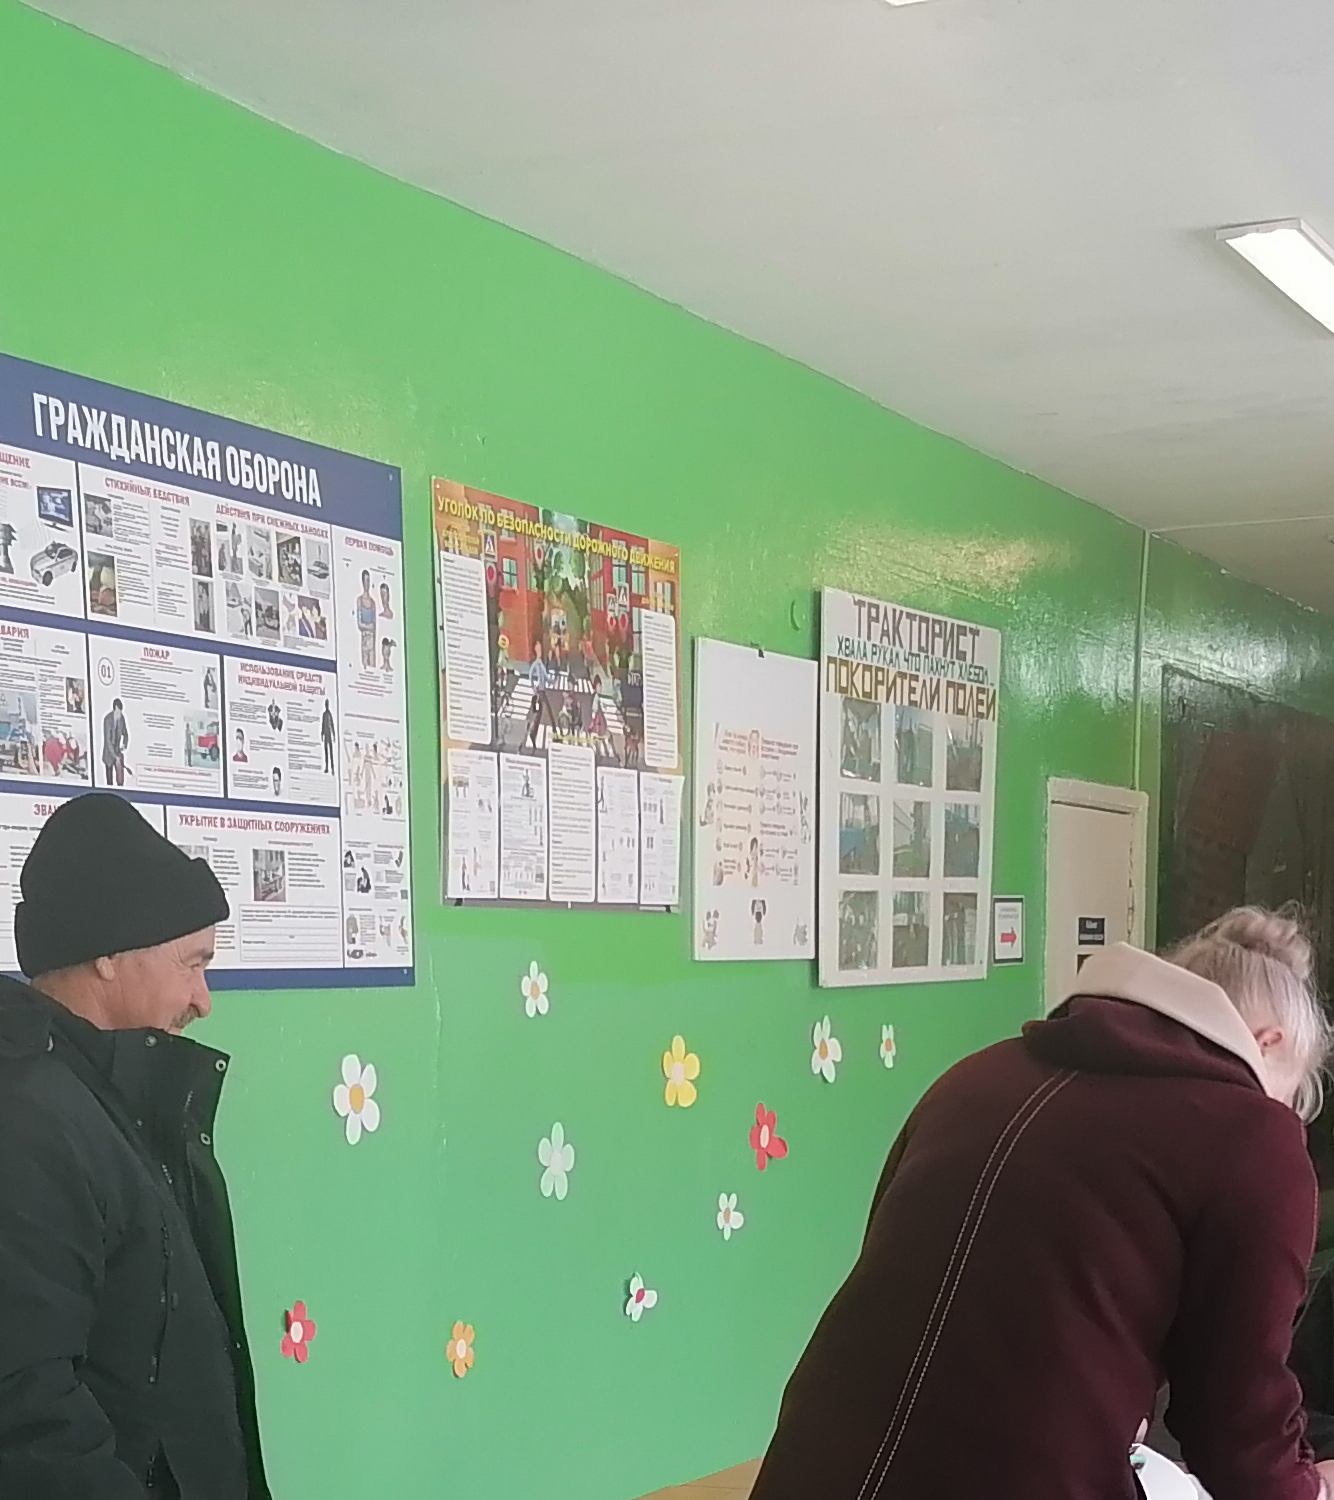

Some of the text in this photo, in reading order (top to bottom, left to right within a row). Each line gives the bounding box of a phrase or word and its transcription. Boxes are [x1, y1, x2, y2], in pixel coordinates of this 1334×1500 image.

[32, 391, 323, 509] ГРАЖДАНСКАЯ ОБОРОНА
[437, 495, 675, 573] УГОЛОК ПО БЕЗОПАСНОСТИ ДОРОЖНОГО ДВИЖЕНИЯ
[143, 647, 170, 660] ПОЖАР
[852, 595, 981, 664] ТРАКТОРИСТ
[101, 665, 111, 678] 01
[837, 635, 867, 661] ХВАЛА
[904, 651, 921, 673] ЧТО
[923, 655, 956, 679] ПАХНУТ
[826, 655, 941, 712] ПОКОРИТЕЛИ
[179, 814, 330, 834] УКРЫТИЕ В ЗАЩИТНЫХ СООРУЖЕНИЯХ
